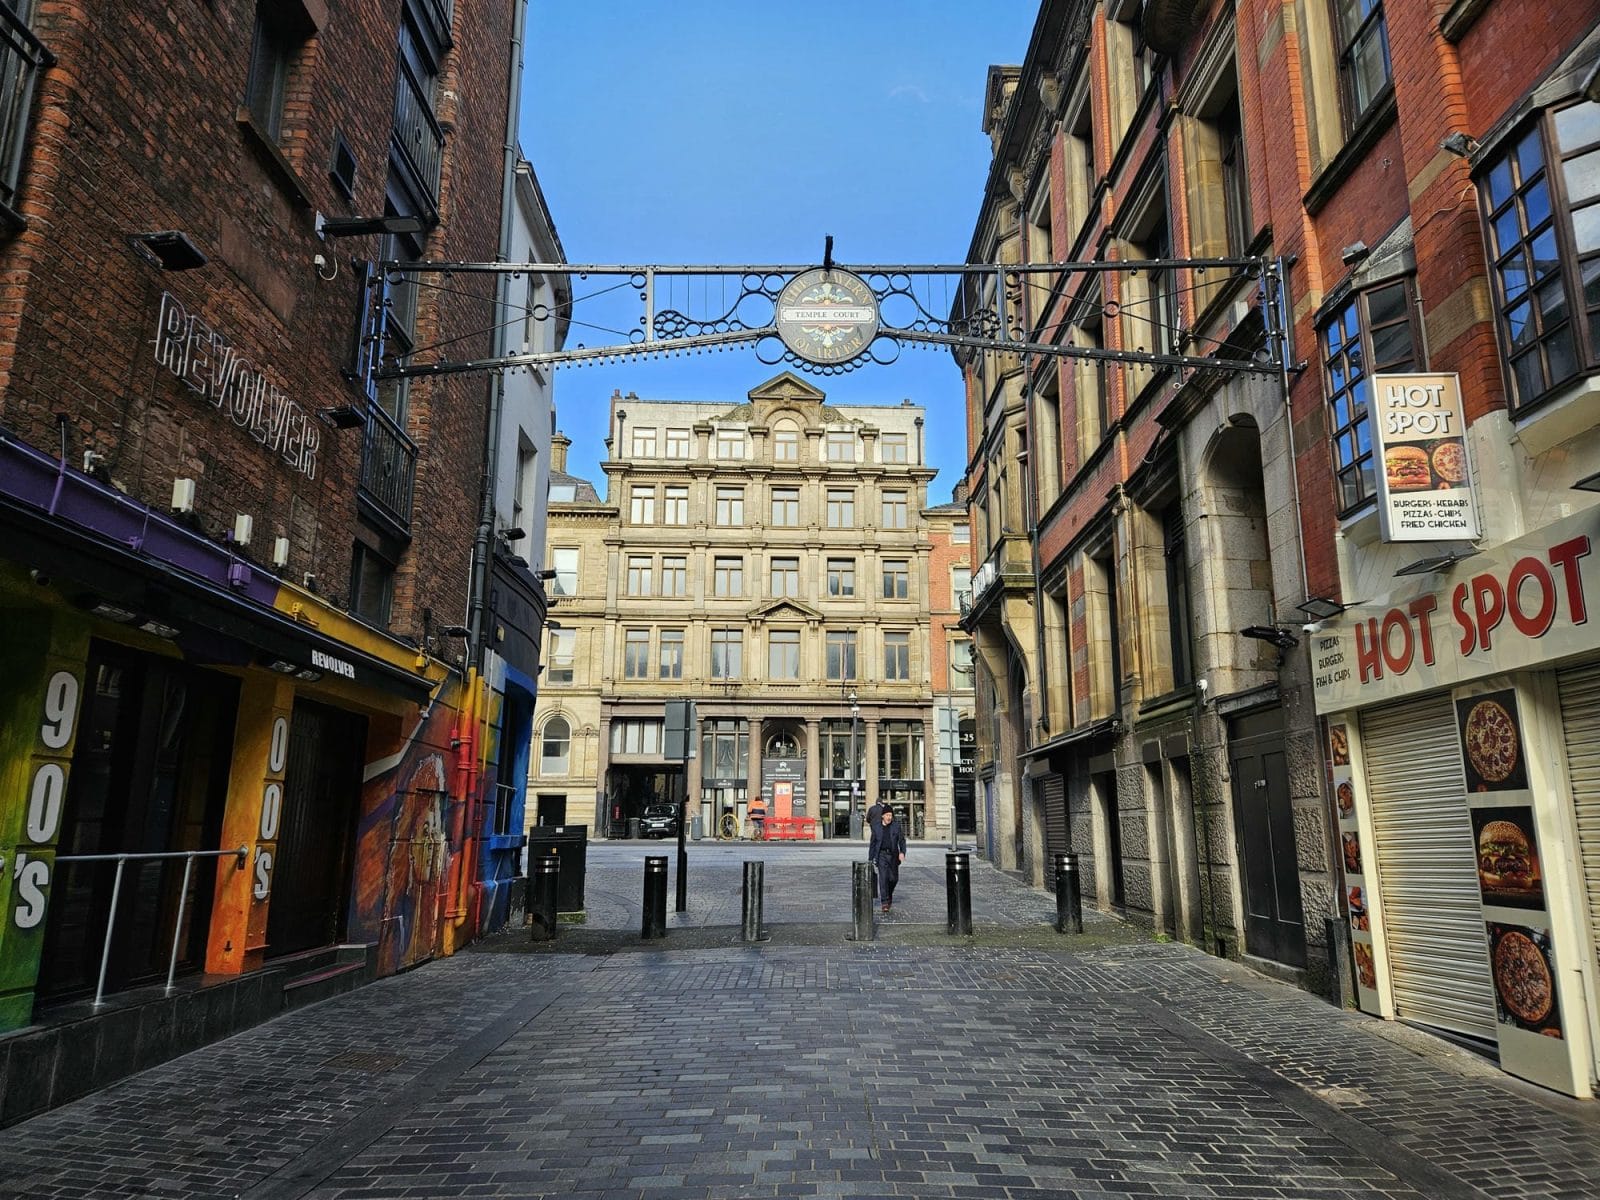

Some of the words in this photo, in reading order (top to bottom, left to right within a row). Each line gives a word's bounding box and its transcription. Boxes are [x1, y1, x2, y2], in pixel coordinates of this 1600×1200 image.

[782, 278, 808, 305] THE
[819, 271, 873, 305] CAVERN
[794, 337, 863, 359] QUARTER
[155, 290, 320, 481] REVOLVER
[1386, 384, 1444, 407] HOT
[1386, 410, 1452, 434] SPOT
[1393, 499, 1432, 508] BURGERS
[1436, 499, 1469, 508] KEBABS
[1403, 510, 1433, 518] PIZZAS
[1437, 509, 1462, 518] CHIPS
[1401, 520, 1425, 529] FRIED
[1427, 519, 1467, 528] CHICKEN
[1354, 593, 1438, 685] HOT
[1452, 534, 1592, 657] SPOT
[1320, 636, 1339, 651] PIZZAS
[311, 649, 356, 680] REVOLVER
[1319, 652, 1344, 669] BURGERS
[1334, 668, 1351, 682] CHIPS
